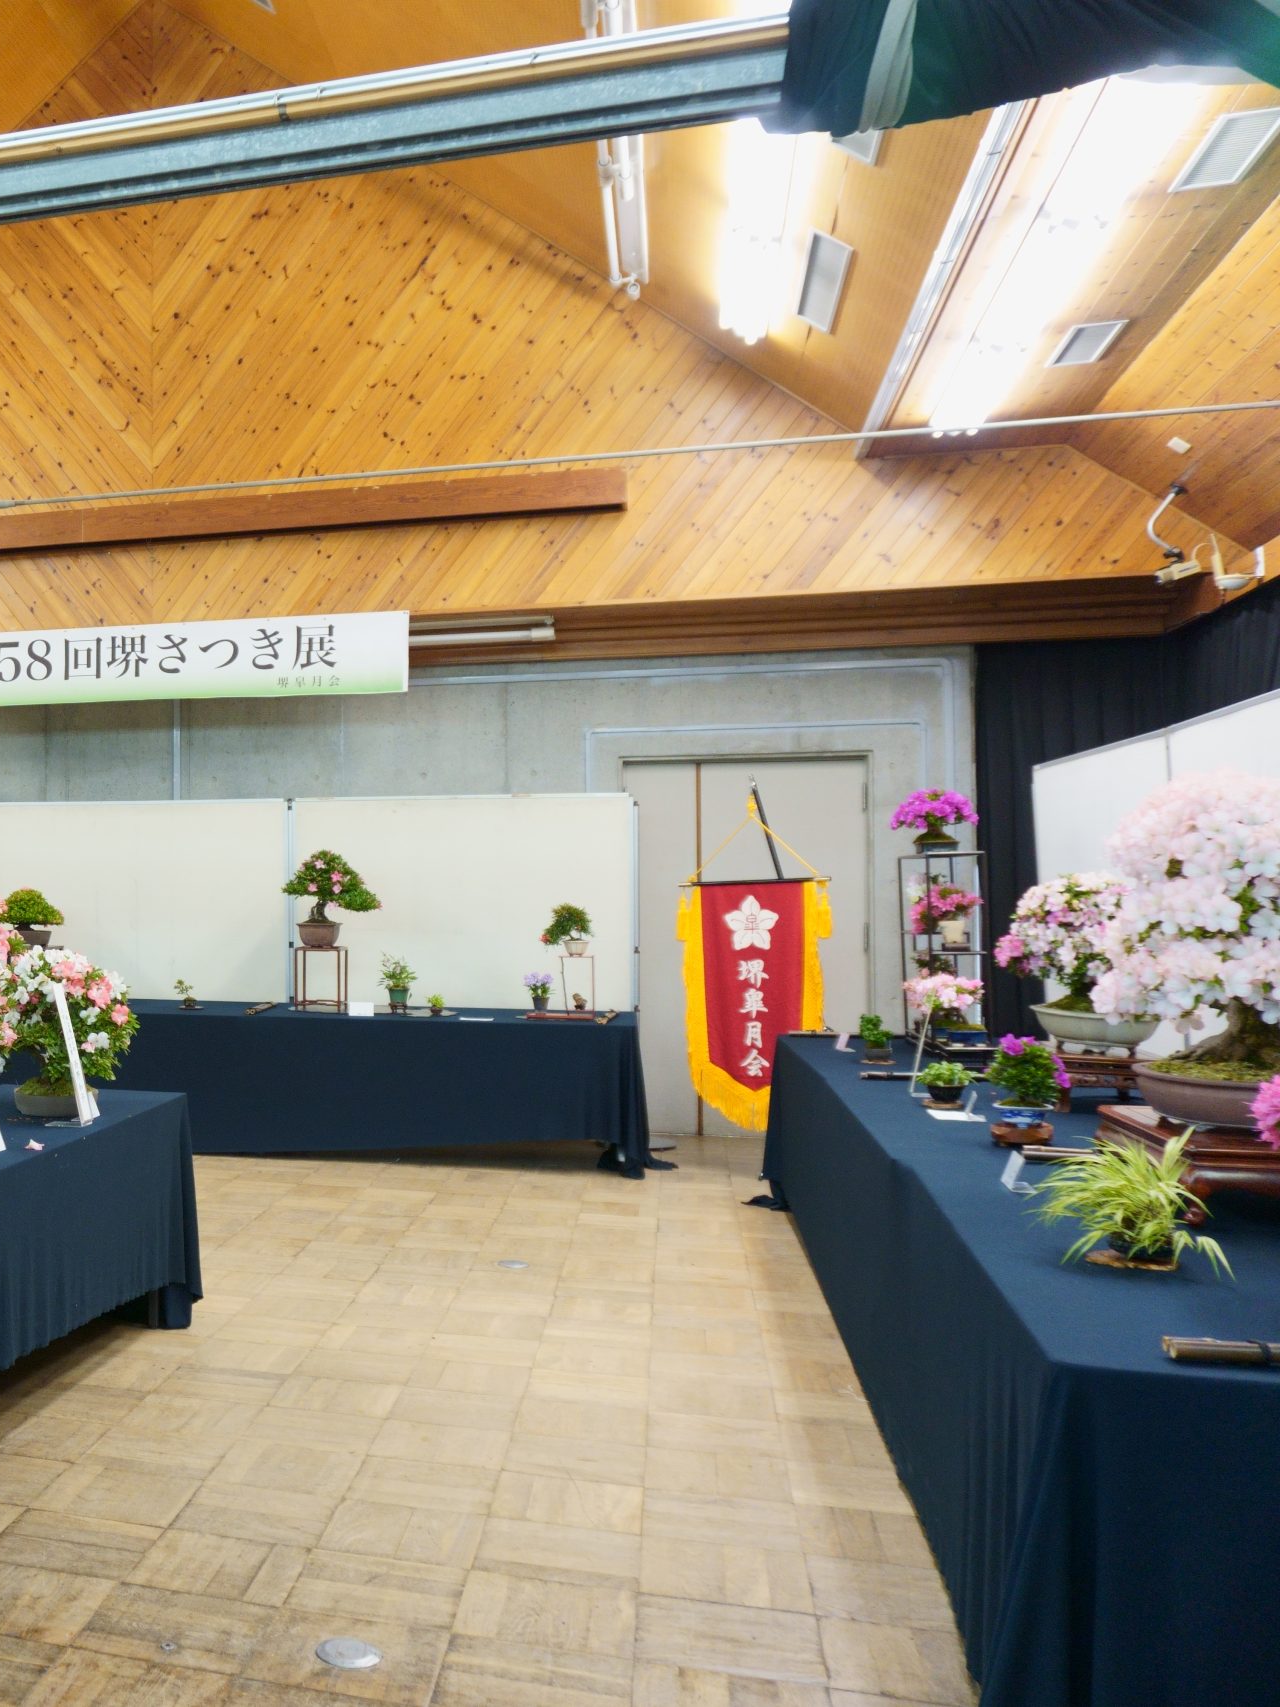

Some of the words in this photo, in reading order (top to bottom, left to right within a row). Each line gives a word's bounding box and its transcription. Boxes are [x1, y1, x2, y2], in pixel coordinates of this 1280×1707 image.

[277, 674, 341, 688] 堺皐月会
[736, 958, 771, 1078] 堺皐月会
